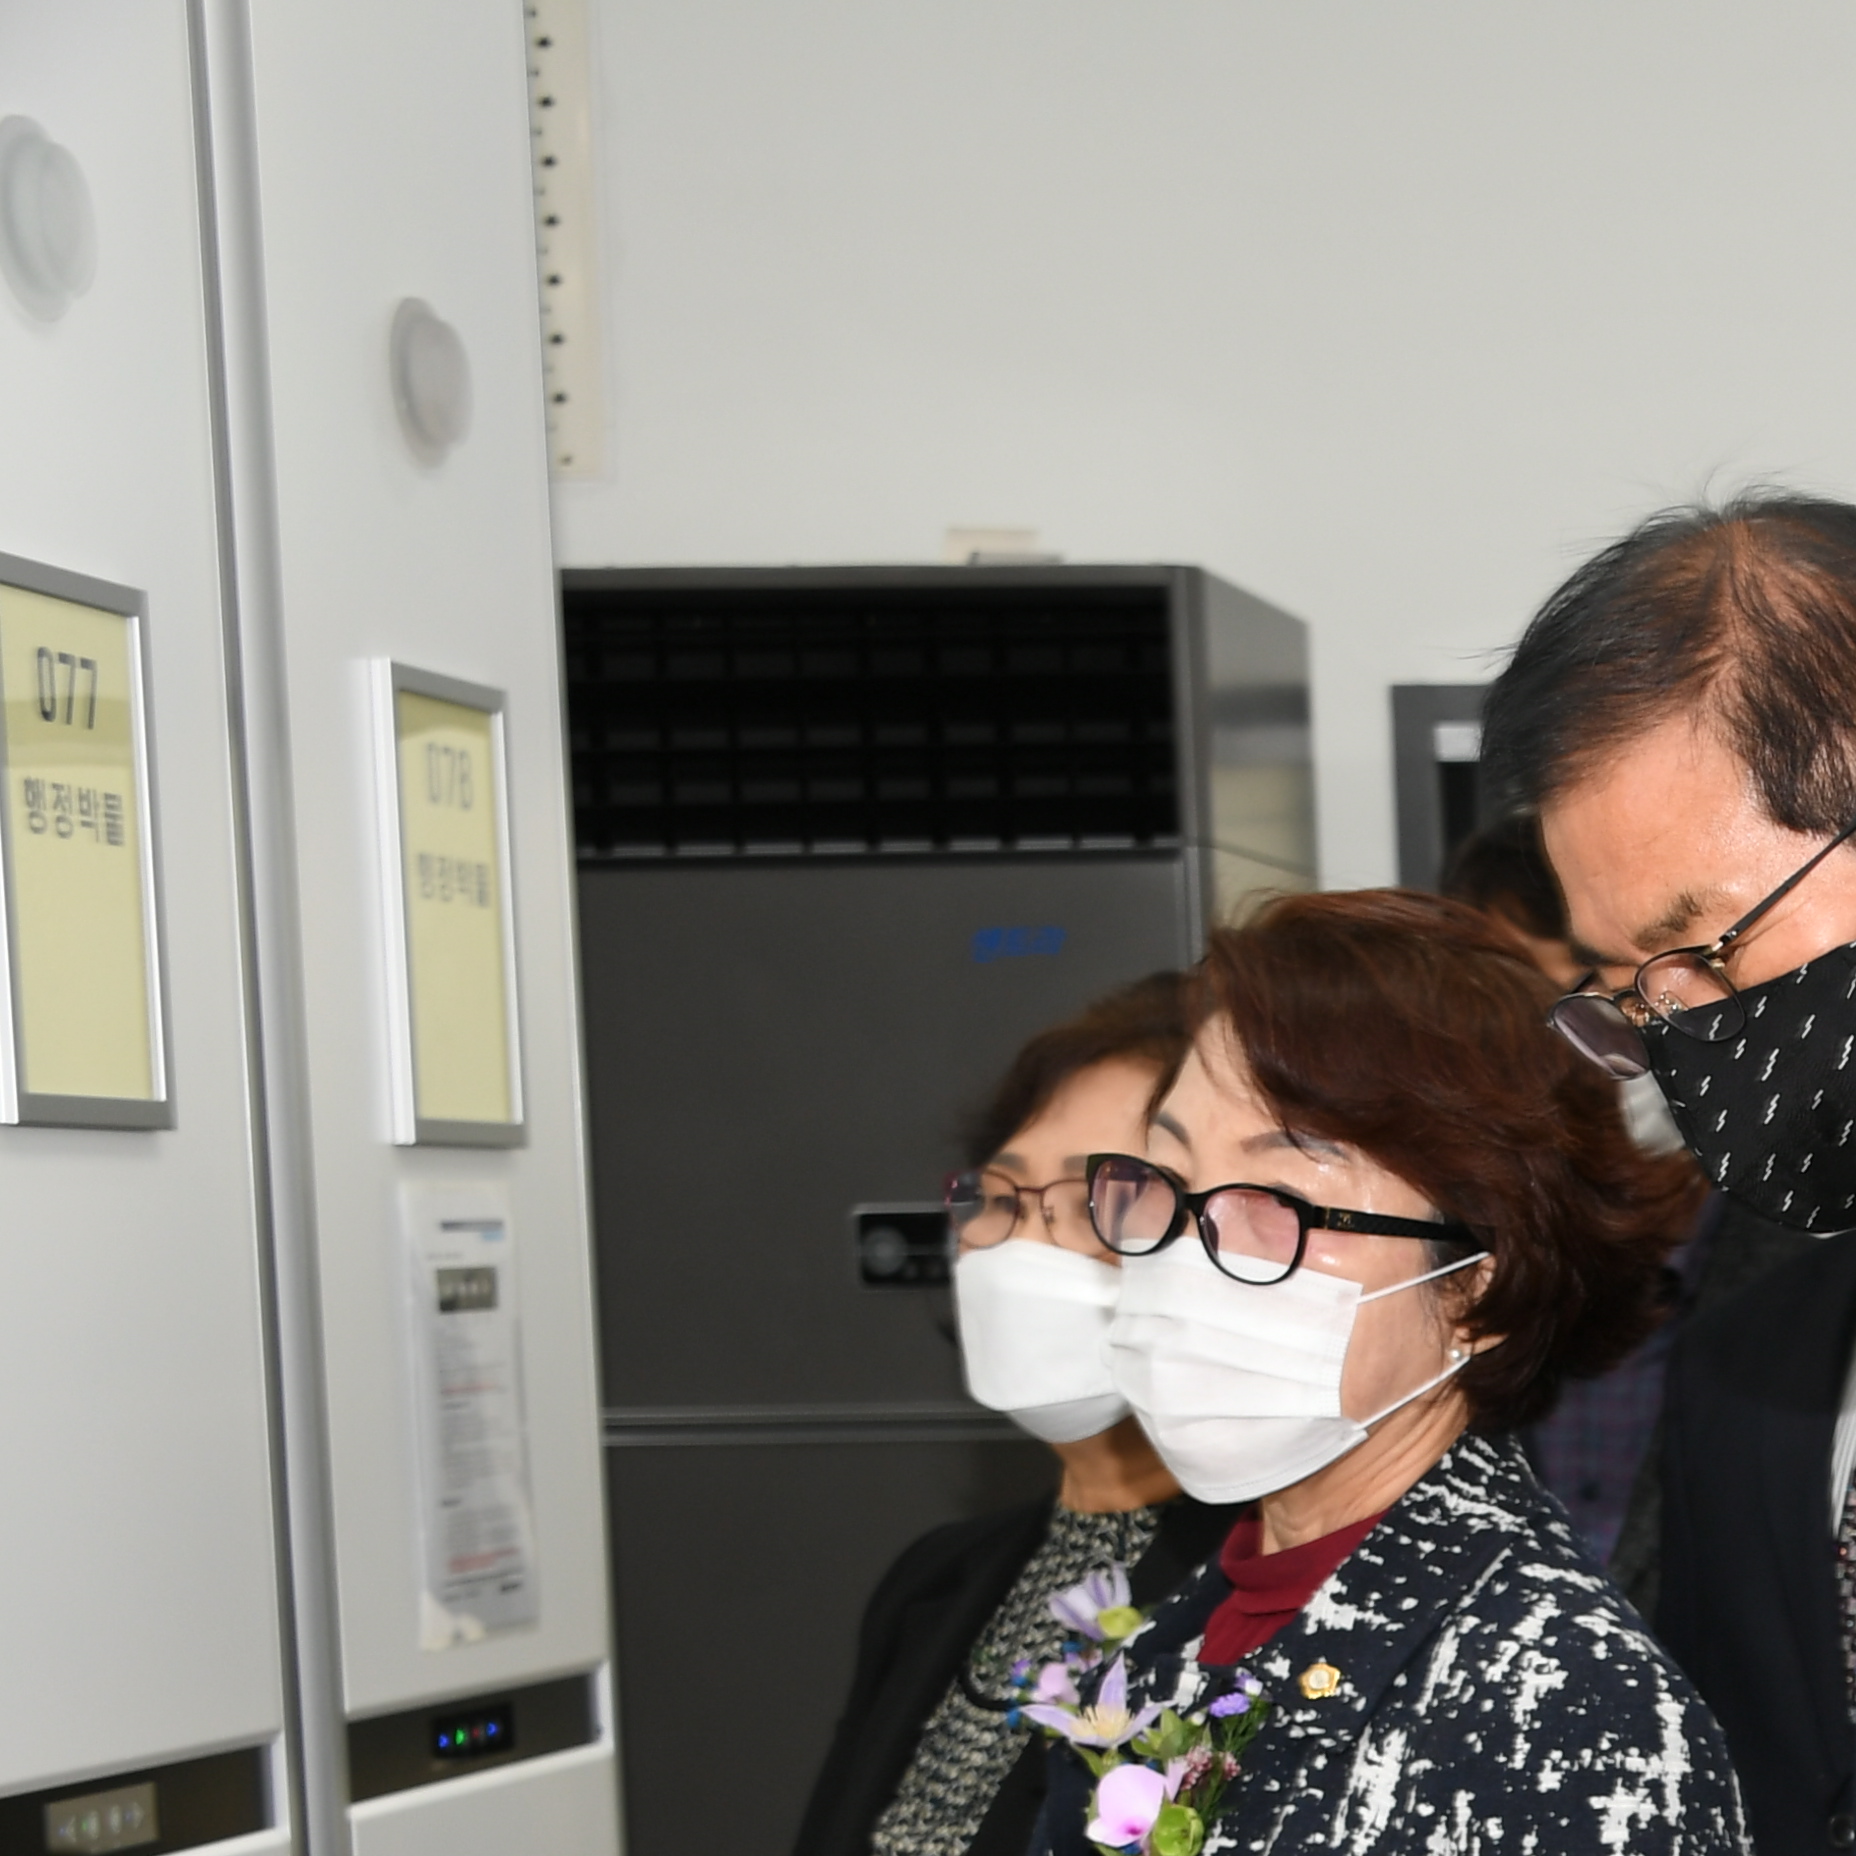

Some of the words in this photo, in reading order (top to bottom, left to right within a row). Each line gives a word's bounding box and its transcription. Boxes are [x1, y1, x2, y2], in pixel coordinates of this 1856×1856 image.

[37, 646, 98, 730] 077
[23, 776, 125, 847] 행정박물
[427, 741, 474, 812] 078
